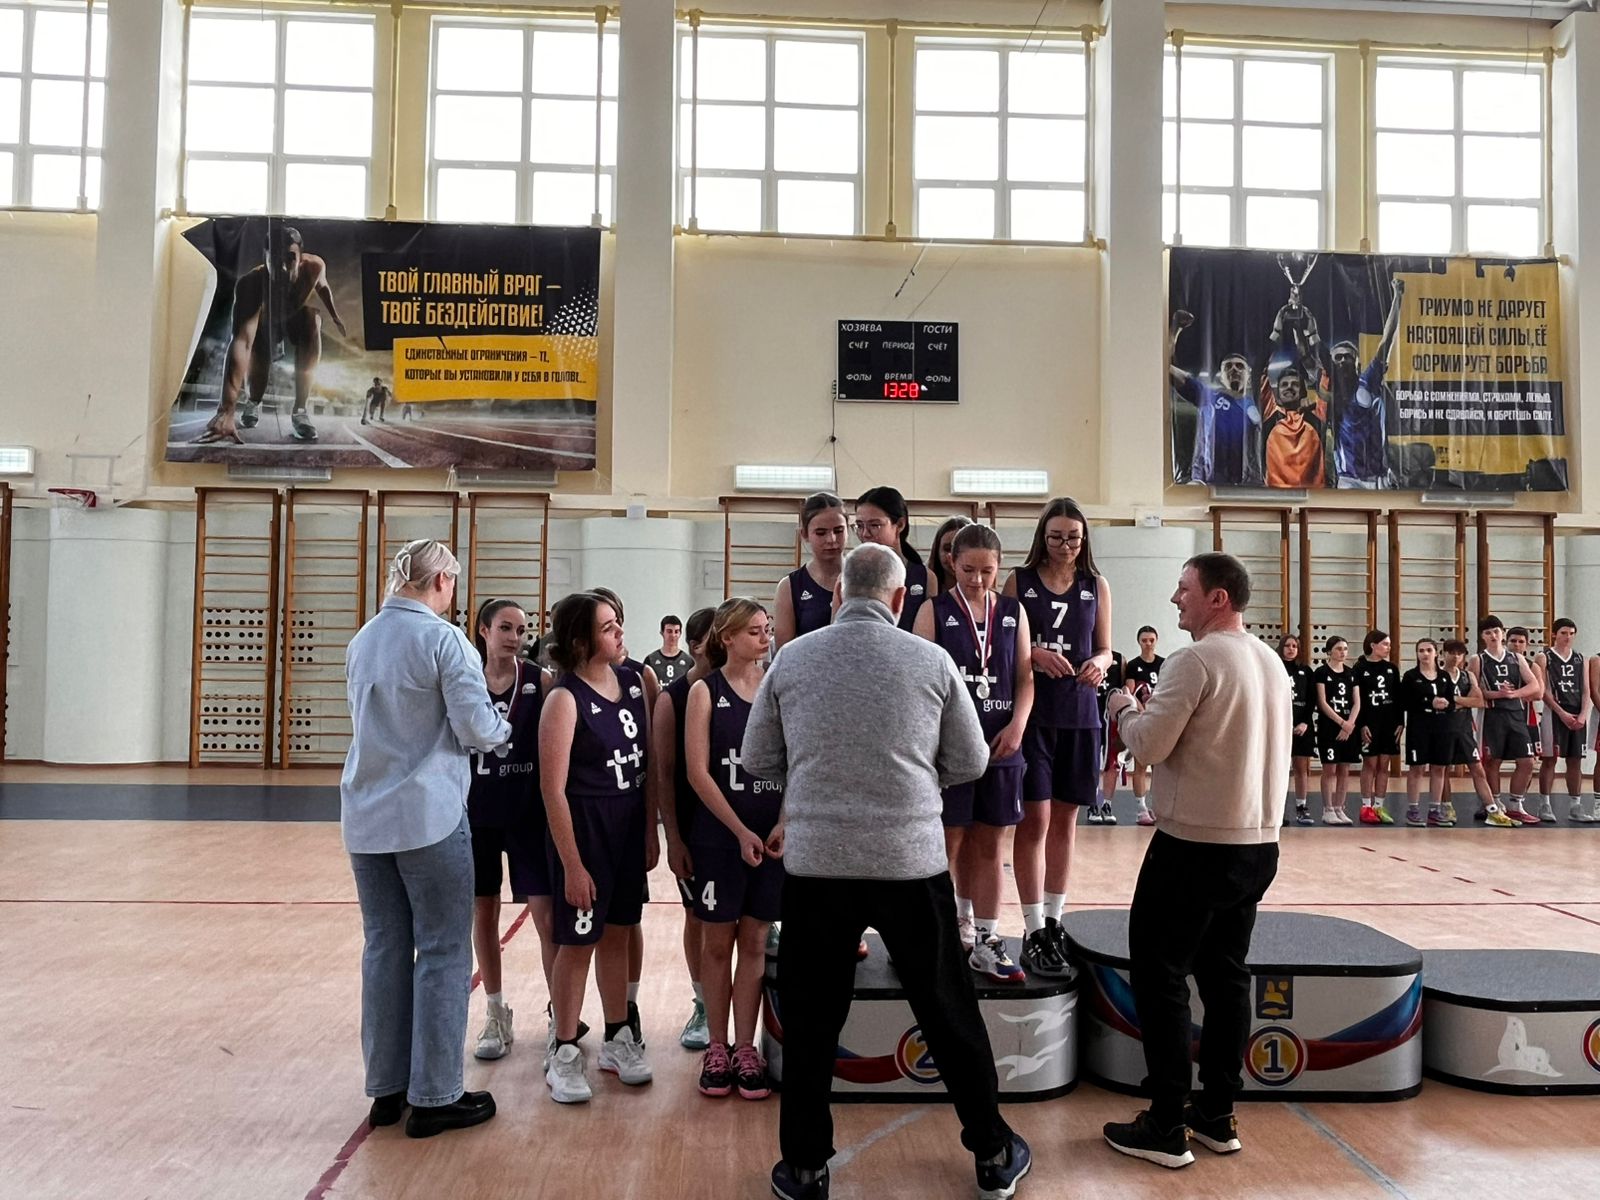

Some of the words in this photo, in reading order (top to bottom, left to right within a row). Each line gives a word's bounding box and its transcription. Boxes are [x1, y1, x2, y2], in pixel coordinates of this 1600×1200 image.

[378, 266, 419, 294] ТВОЙ
[424, 269, 500, 295] ГЛАВНЫЙ
[504, 274, 542, 296] ВРАГ
[381, 297, 421, 325] ТВОЁ
[425, 298, 543, 329] БЕЗДЕЙСТВИЕ!
[1418, 298, 1474, 316] ТРИУМФ
[1478, 299, 1493, 318] НЕ
[1496, 300, 1547, 321] ДАРУЕТ
[840, 323, 882, 332] ХОЗЯЕВА
[922, 325, 953, 334] ГОСТИ
[1406, 323, 1485, 348] НАСТОЯЩЕЙ
[882, 341, 915, 350] ПЕРИОД
[405, 348, 468, 361] ЕДИНСТВЕННЫЕ
[470, 350, 528, 362] ОГРАНИЧЕНИЯ
[1412, 354, 1492, 373] ФОРМИРУЕТ
[1496, 356, 1548, 374] БОРЬБА
[404, 368, 442, 380] КОТОРЫЕ
[444, 370, 457, 380] ВЫ
[459, 370, 512, 382] УСТАНОВИЛИ
[514, 371, 520, 382] У
[522, 370, 542, 382] СЕБЯ
[544, 372, 549, 382] В
[1428, 410, 1434, 419] И
[1435, 410, 1444, 420] НЕ
[1051, 601, 1068, 629] 7
[666, 664, 674, 678] 8
[1495, 664, 1509, 676] 13
[1560, 664, 1574, 676] 12
[1150, 672, 1158, 684] 9
[1376, 675, 1386, 688] 2
[1338, 682, 1346, 696] 3
[1430, 683, 1438, 696] 1
[618, 708, 638, 740] 8
[1327, 748, 1335, 760] 3
[1411, 749, 1417, 762] 1
[1472, 748, 1480, 760] 4
[499, 762, 533, 776] group
[702, 880, 717, 911] 4
[574, 907, 594, 936] 8
[1262, 1038, 1285, 1073] 1
